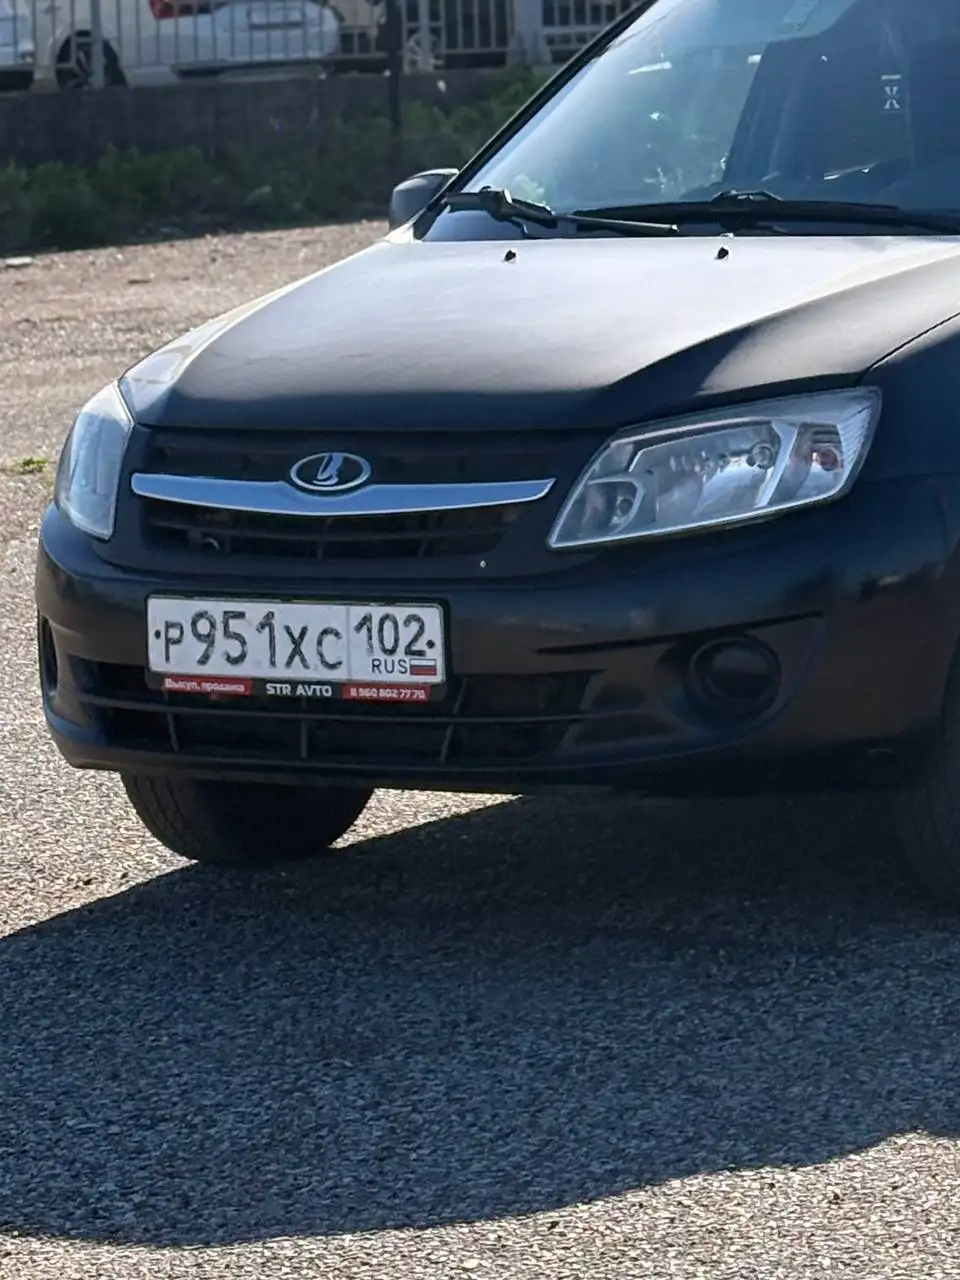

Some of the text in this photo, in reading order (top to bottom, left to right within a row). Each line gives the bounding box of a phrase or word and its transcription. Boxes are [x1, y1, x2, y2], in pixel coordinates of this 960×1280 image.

[353, 612, 427, 658] 102
[371, 657, 409, 675] RUS
[265, 682, 333, 697] STR AVTO
